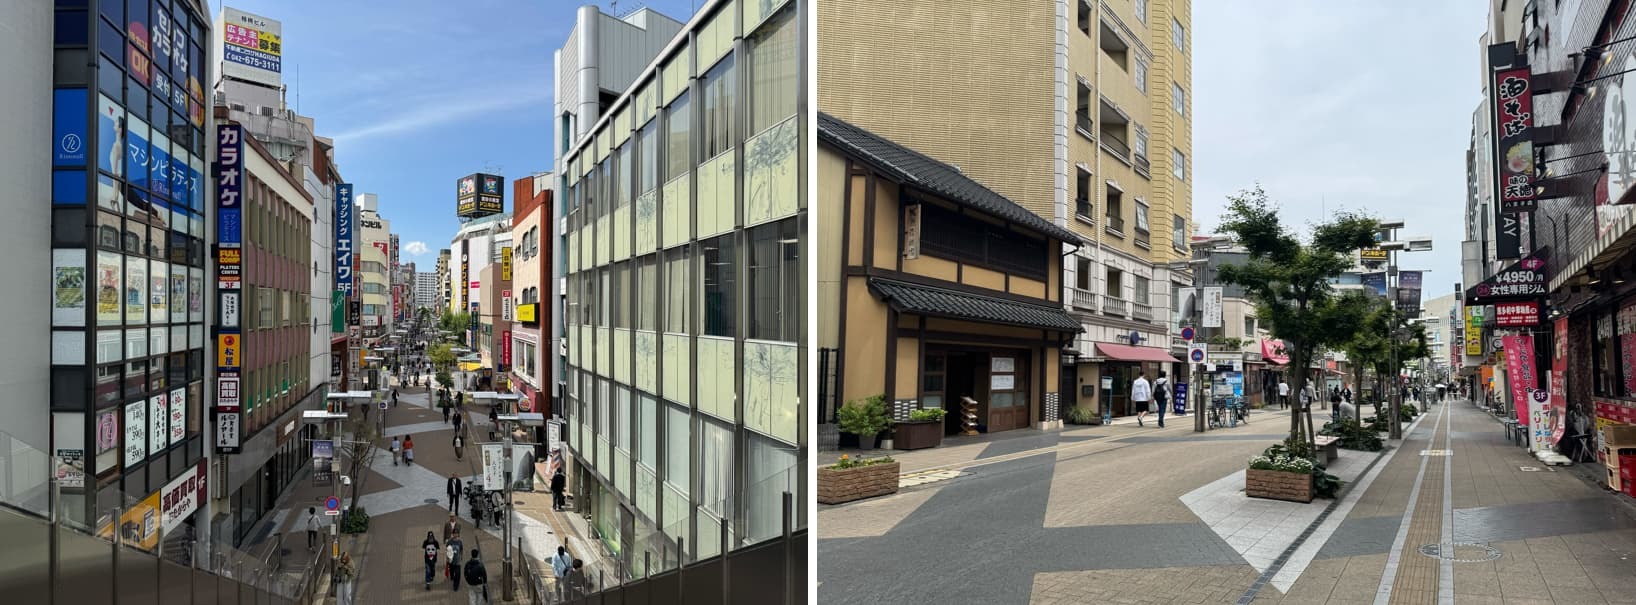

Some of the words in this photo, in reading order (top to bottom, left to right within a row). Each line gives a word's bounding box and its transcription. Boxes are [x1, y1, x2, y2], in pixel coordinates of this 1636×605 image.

[227, 25, 257, 39] 広告主
[227, 34, 257, 47] テナント
[152, 25, 188, 72] カラオケ
[231, 54, 279, 71] 042-675-3111
[1500, 77, 1530, 137] 油そば
[129, 143, 198, 193] マシンピラティス
[221, 128, 238, 206] カラオケ
[1509, 176, 1528, 185] 味の
[339, 187, 349, 236] キャッシング
[1503, 212, 1517, 237] TAY
[219, 250, 240, 258] FULL
[337, 239, 351, 280] エイワ
[1526, 260, 1538, 268] 4F
[337, 282, 351, 292] 5F
[1491, 284, 1545, 295] 女性専用ジム
[225, 347, 235, 366] 松屋
[1535, 392, 1546, 400] 3F
[163, 475, 196, 513] 高価買取
